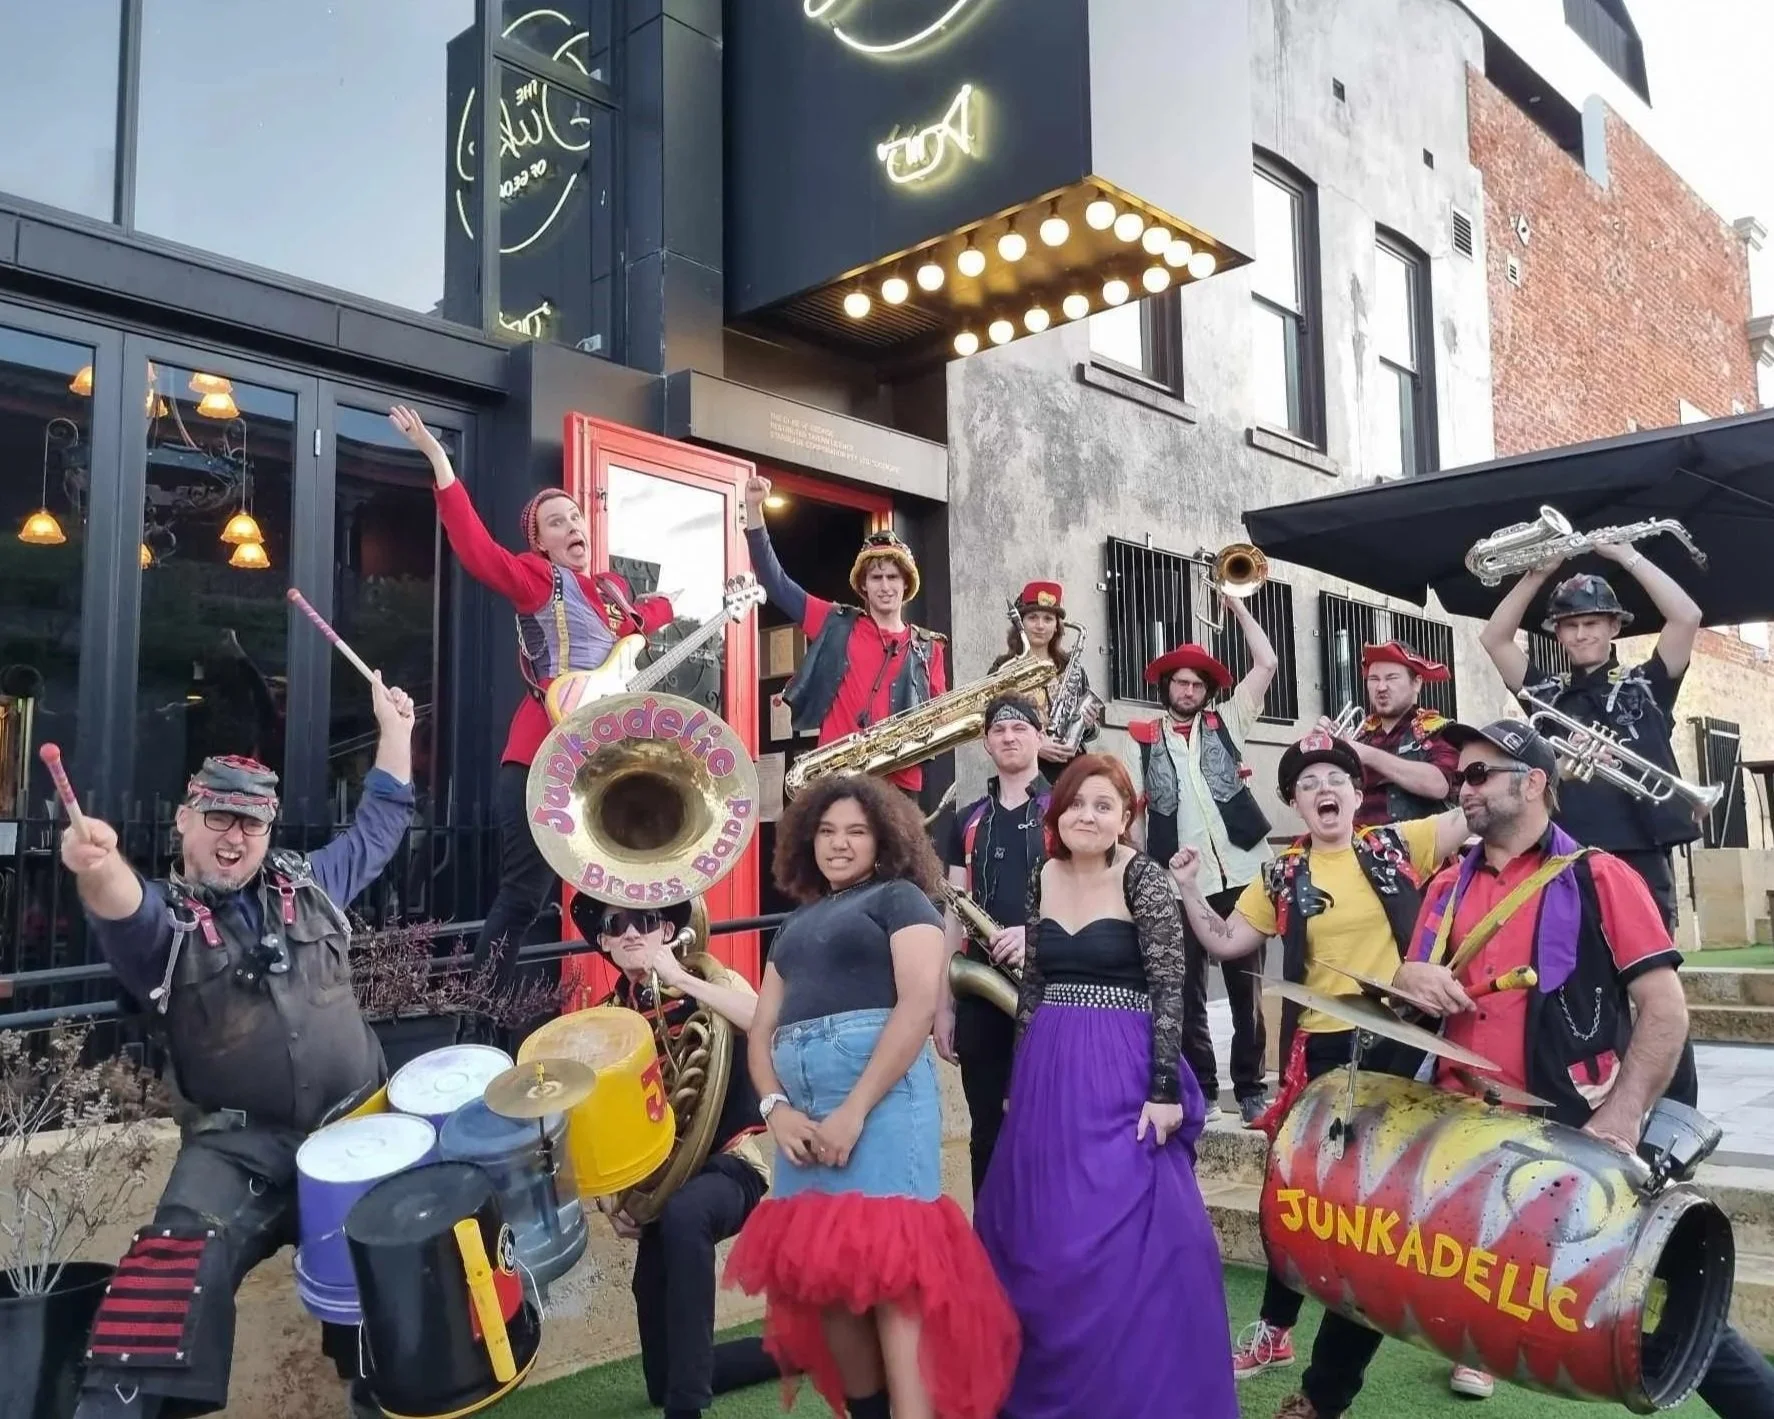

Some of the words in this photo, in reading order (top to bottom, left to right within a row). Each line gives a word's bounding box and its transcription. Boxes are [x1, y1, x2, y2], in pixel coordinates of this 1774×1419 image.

[531, 697, 736, 836] Junkadelic
[578, 861, 687, 902] Brass
[691, 797, 753, 879] Band
[1276, 1188, 1579, 1333] JUNKADELIC
